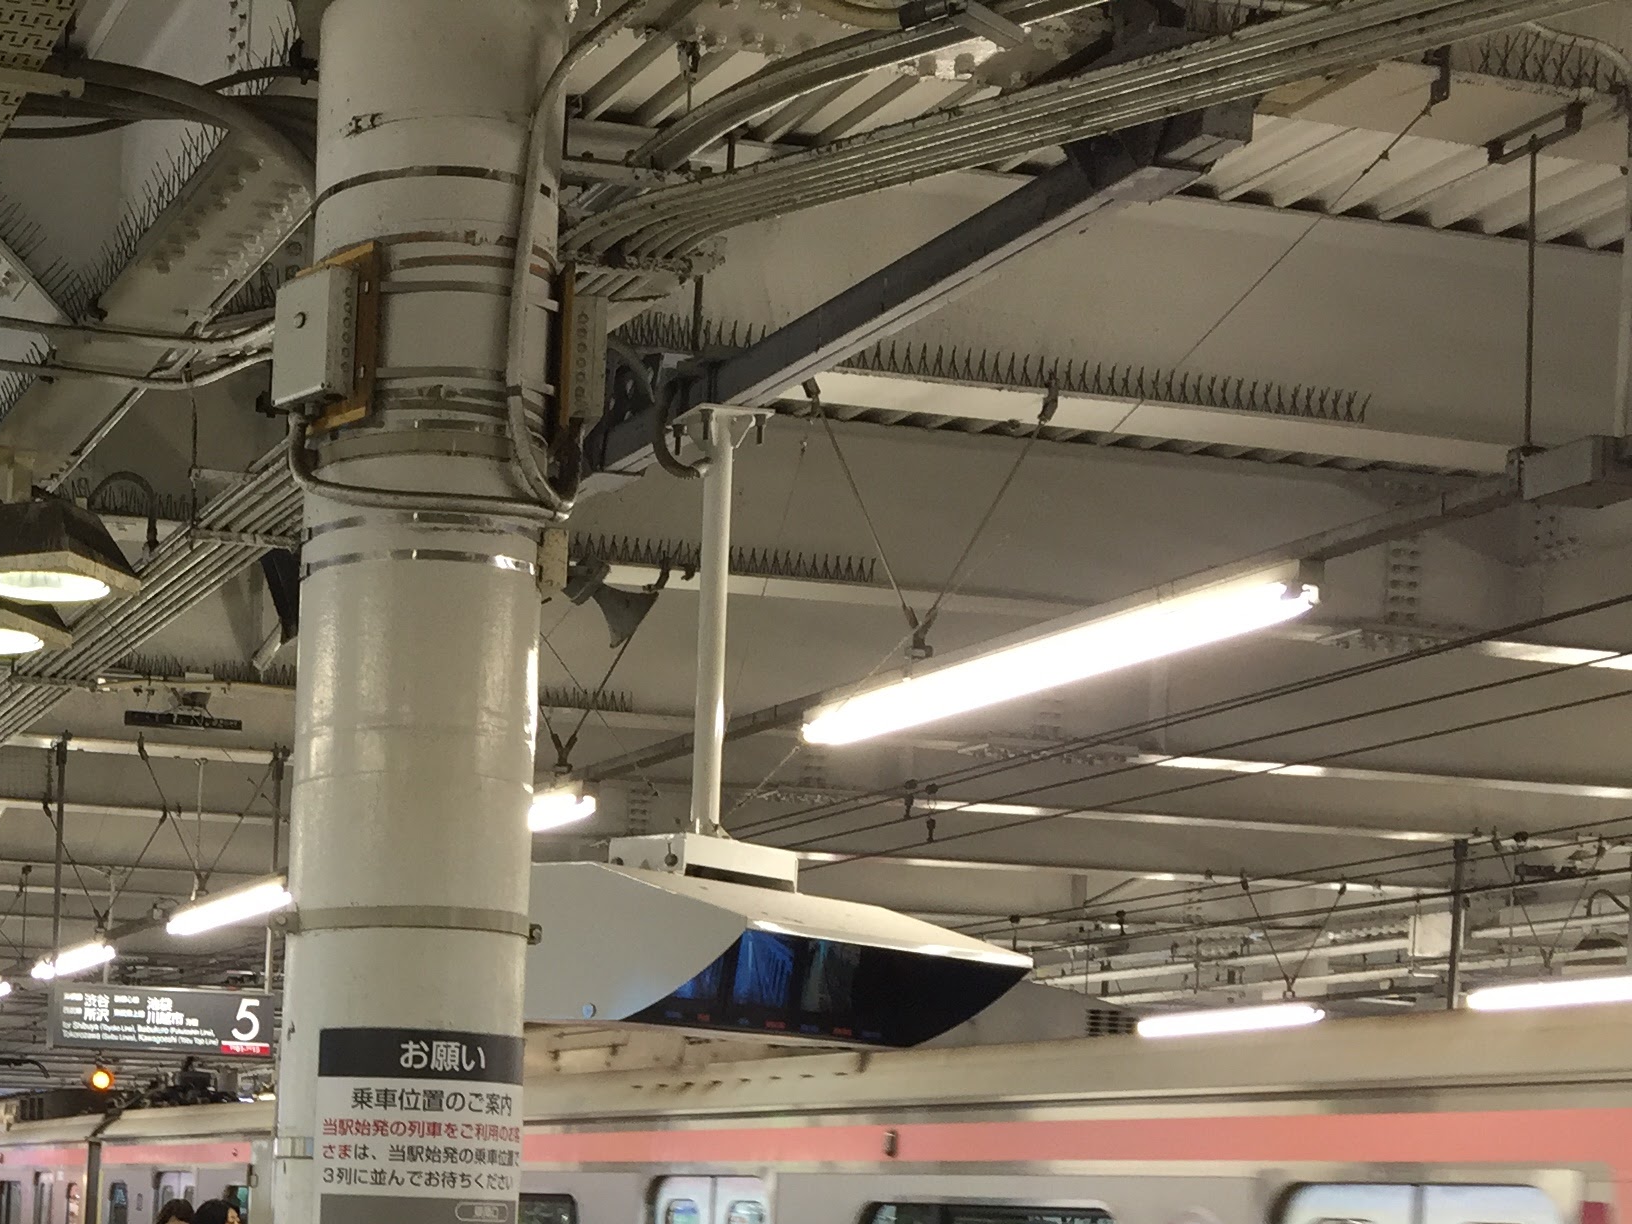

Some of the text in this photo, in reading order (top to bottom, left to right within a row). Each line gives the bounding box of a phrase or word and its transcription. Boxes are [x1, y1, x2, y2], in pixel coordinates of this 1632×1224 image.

[83, 993, 110, 1008] 渋谷
[231, 998, 260, 1041] 5
[399, 1039, 487, 1073] お願い
[351, 1087, 513, 1117] 乗車位置のご案内
[322, 1167, 514, 1191] 3列に並んでお待ちください
